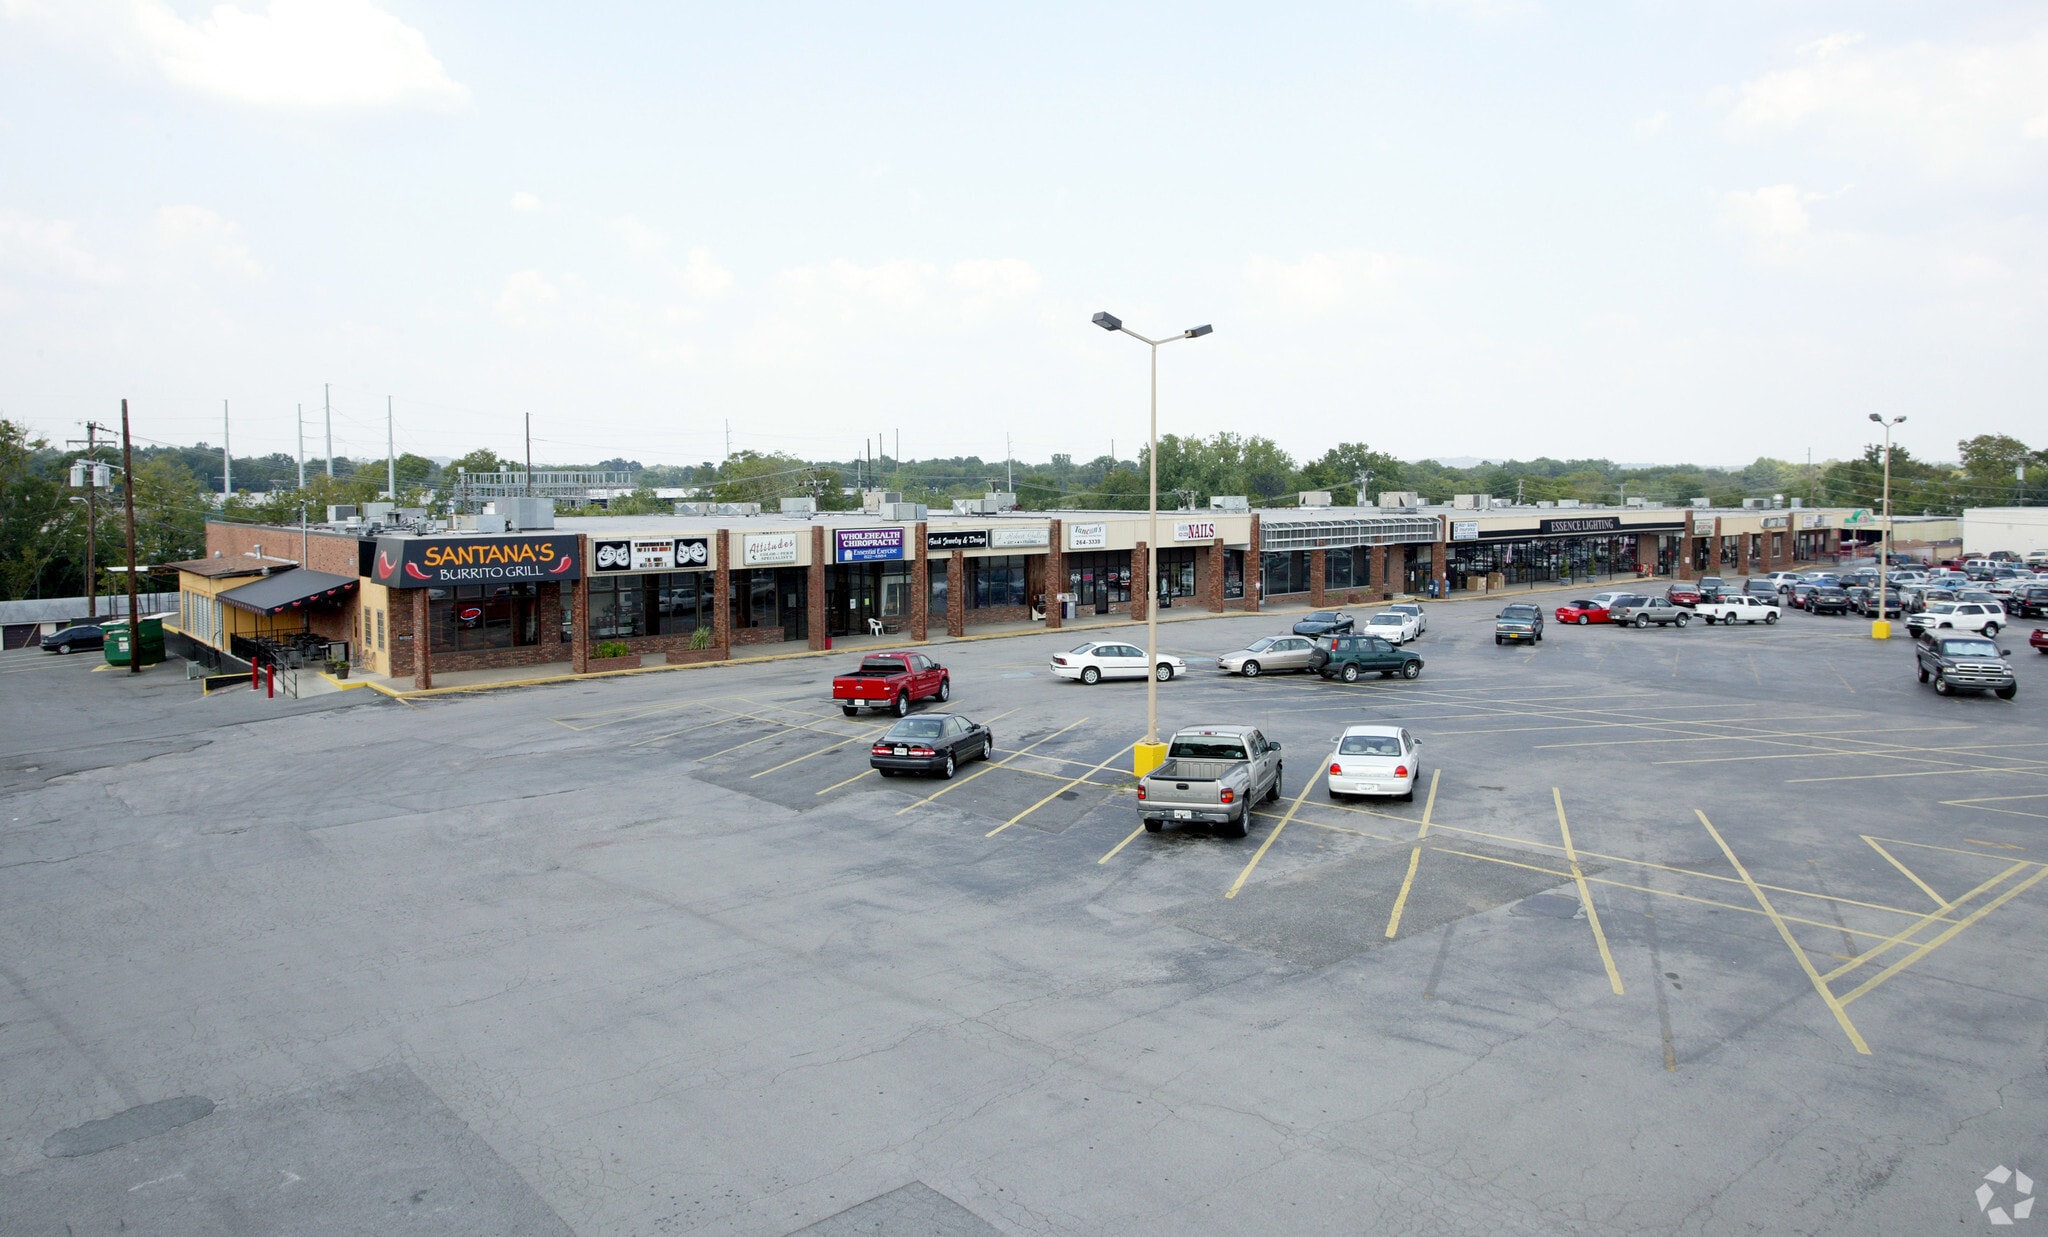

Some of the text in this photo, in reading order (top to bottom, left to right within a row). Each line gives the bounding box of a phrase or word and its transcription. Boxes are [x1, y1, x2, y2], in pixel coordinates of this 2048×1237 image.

[1188, 523, 1214, 538] NAILS
[1551, 519, 1614, 532] ESSENCE LIGHTING
[841, 531, 900, 540] WHOLEHEALTH
[749, 538, 794, 554] Attitudes
[843, 539, 900, 547] CHIROPRACTIC
[424, 543, 555, 566] SANTANA'S
[440, 566, 543, 580] BURRITO GRILL
